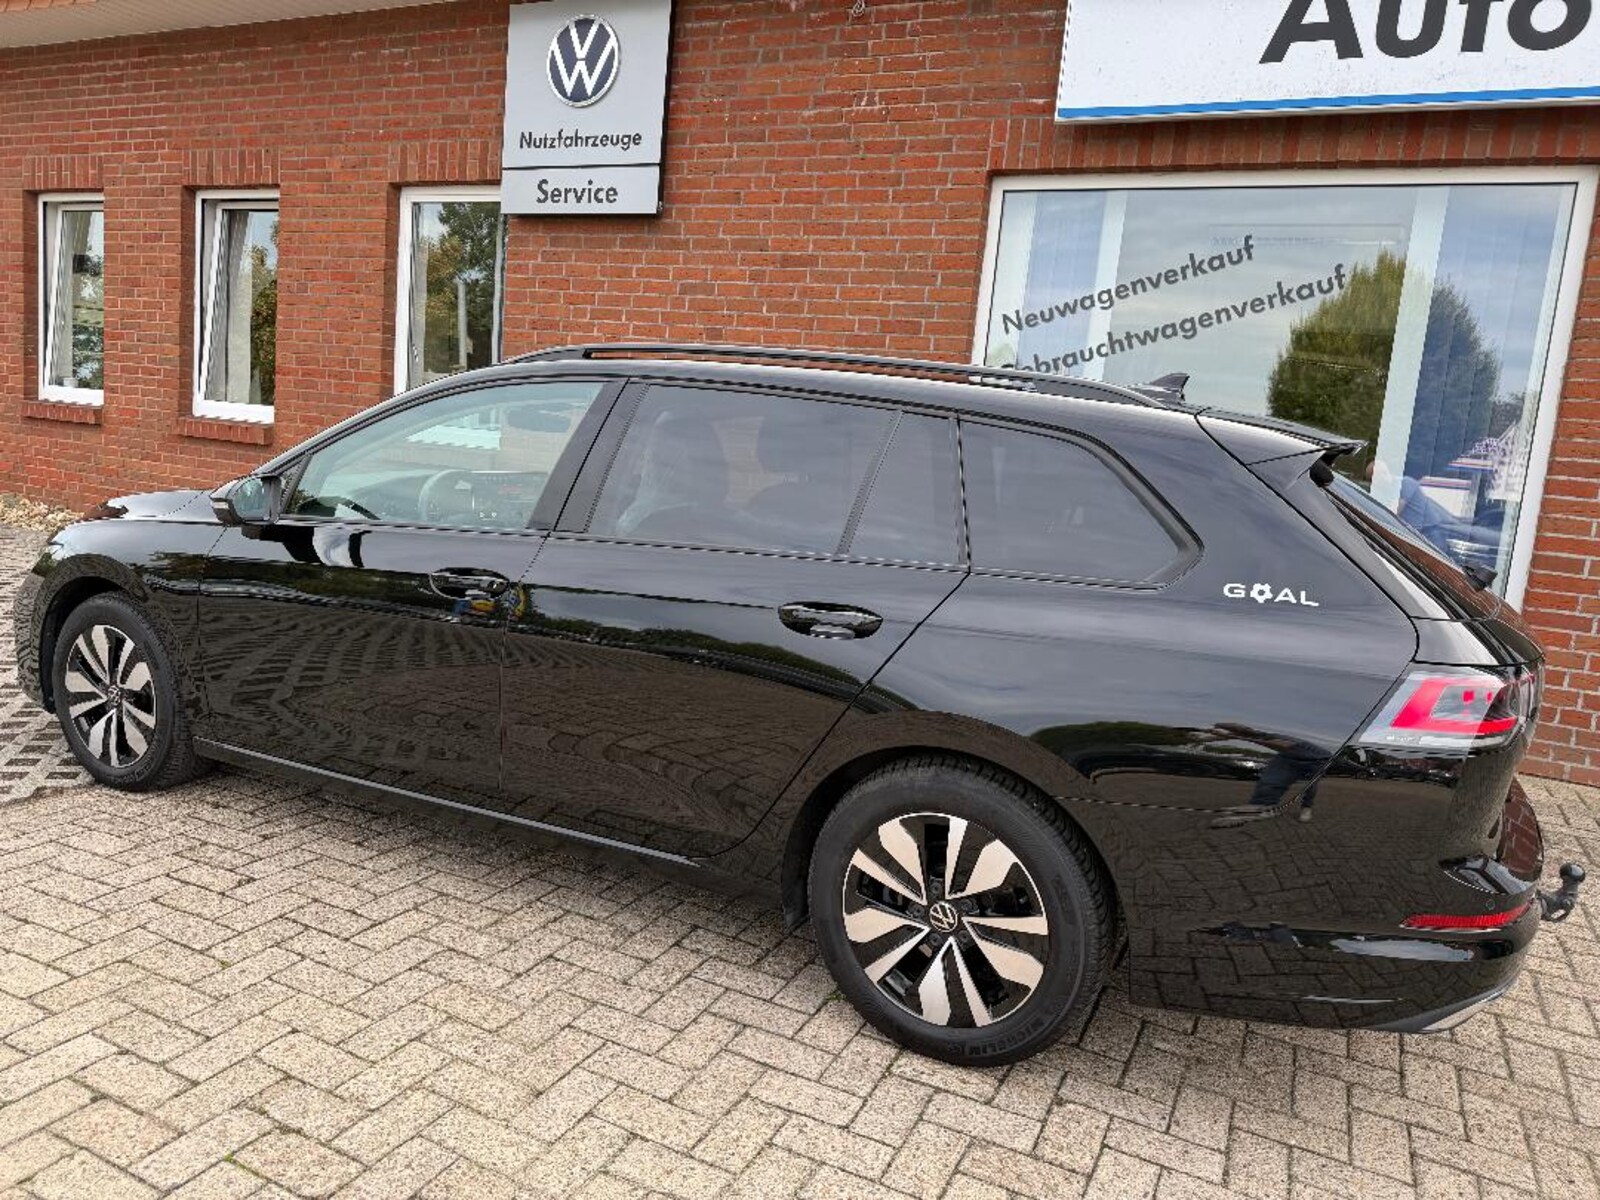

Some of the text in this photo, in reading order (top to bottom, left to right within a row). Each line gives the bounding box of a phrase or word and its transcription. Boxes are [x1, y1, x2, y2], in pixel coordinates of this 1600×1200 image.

[519, 128, 643, 151] Nutzfahrzeuge
[535, 178, 619, 204] Service
[1001, 234, 1255, 335] Neuwagenverkauf
[1002, 263, 1347, 373] brauchtwagenverkauf
[1222, 582, 1320, 607] GOAL
